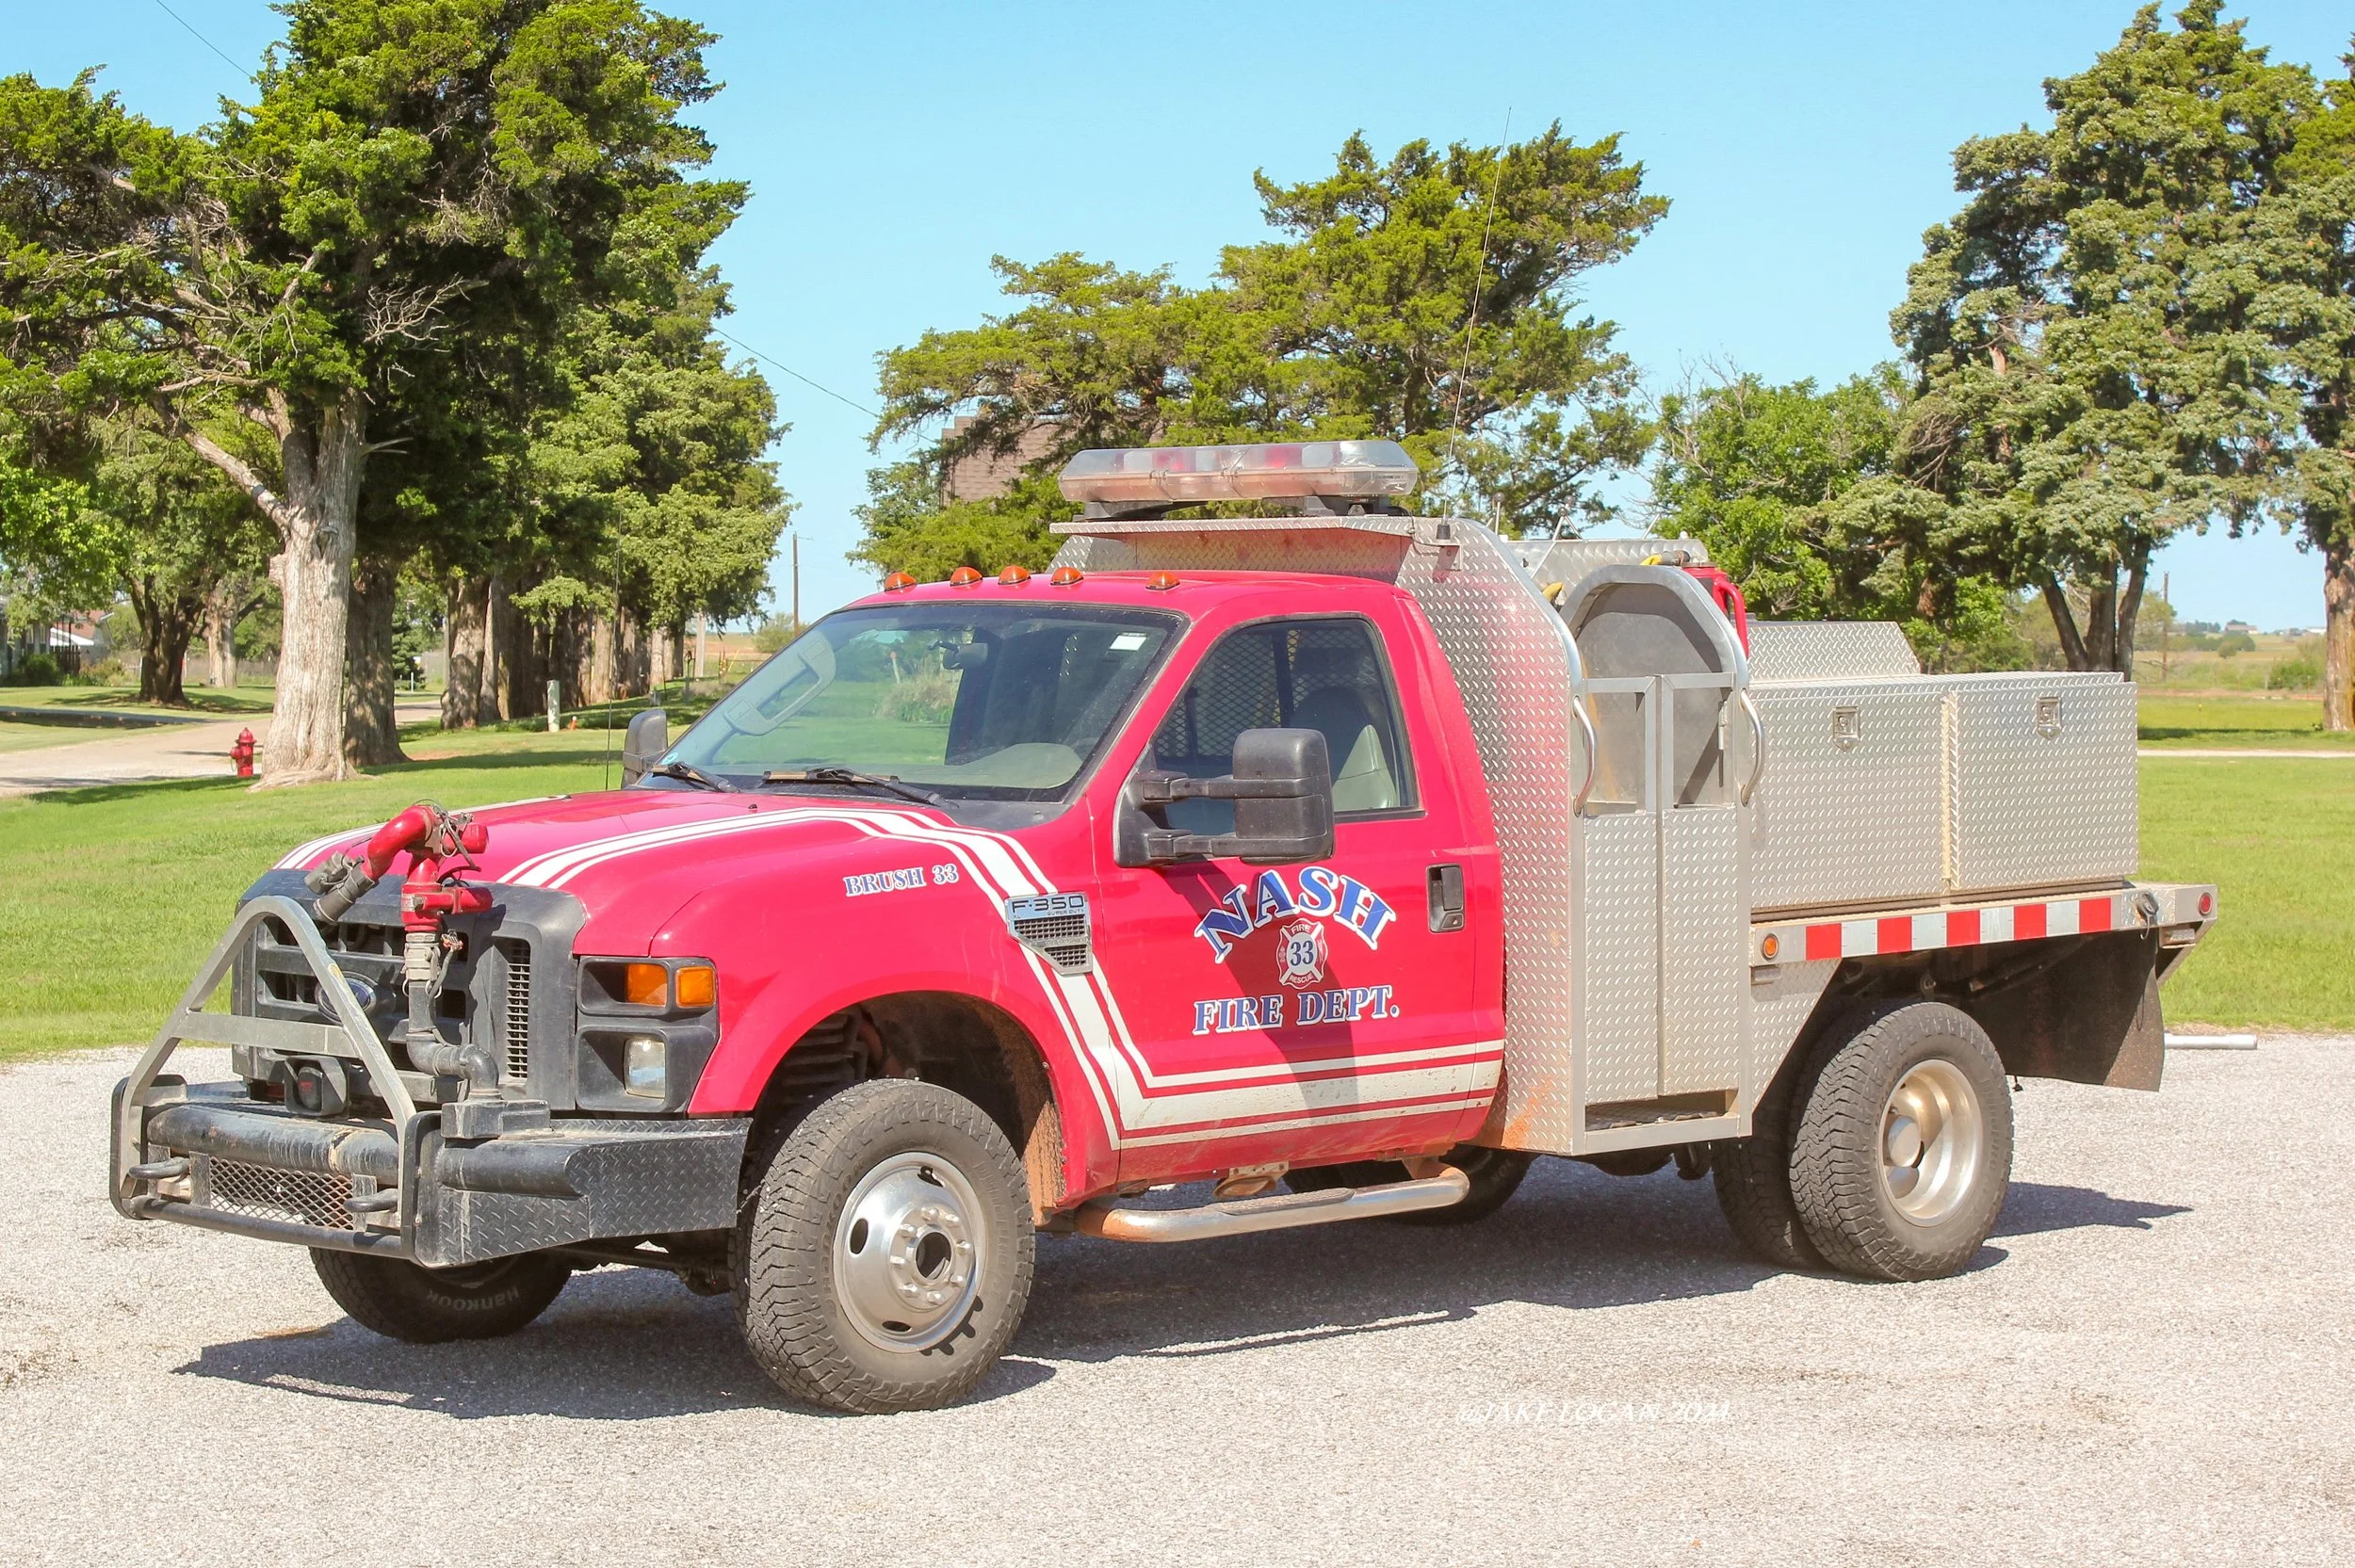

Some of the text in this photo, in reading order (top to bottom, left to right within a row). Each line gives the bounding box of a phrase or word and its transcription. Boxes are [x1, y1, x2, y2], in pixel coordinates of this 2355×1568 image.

[843, 863, 959, 897] BRUSH 33
[1194, 865, 1397, 964] NASH
[1291, 924, 1311, 935] FIRE
[1290, 940, 1314, 966] 33
[1289, 972, 1314, 984] RESCUE
[1193, 985, 1400, 1035] FIRE DEPT.
